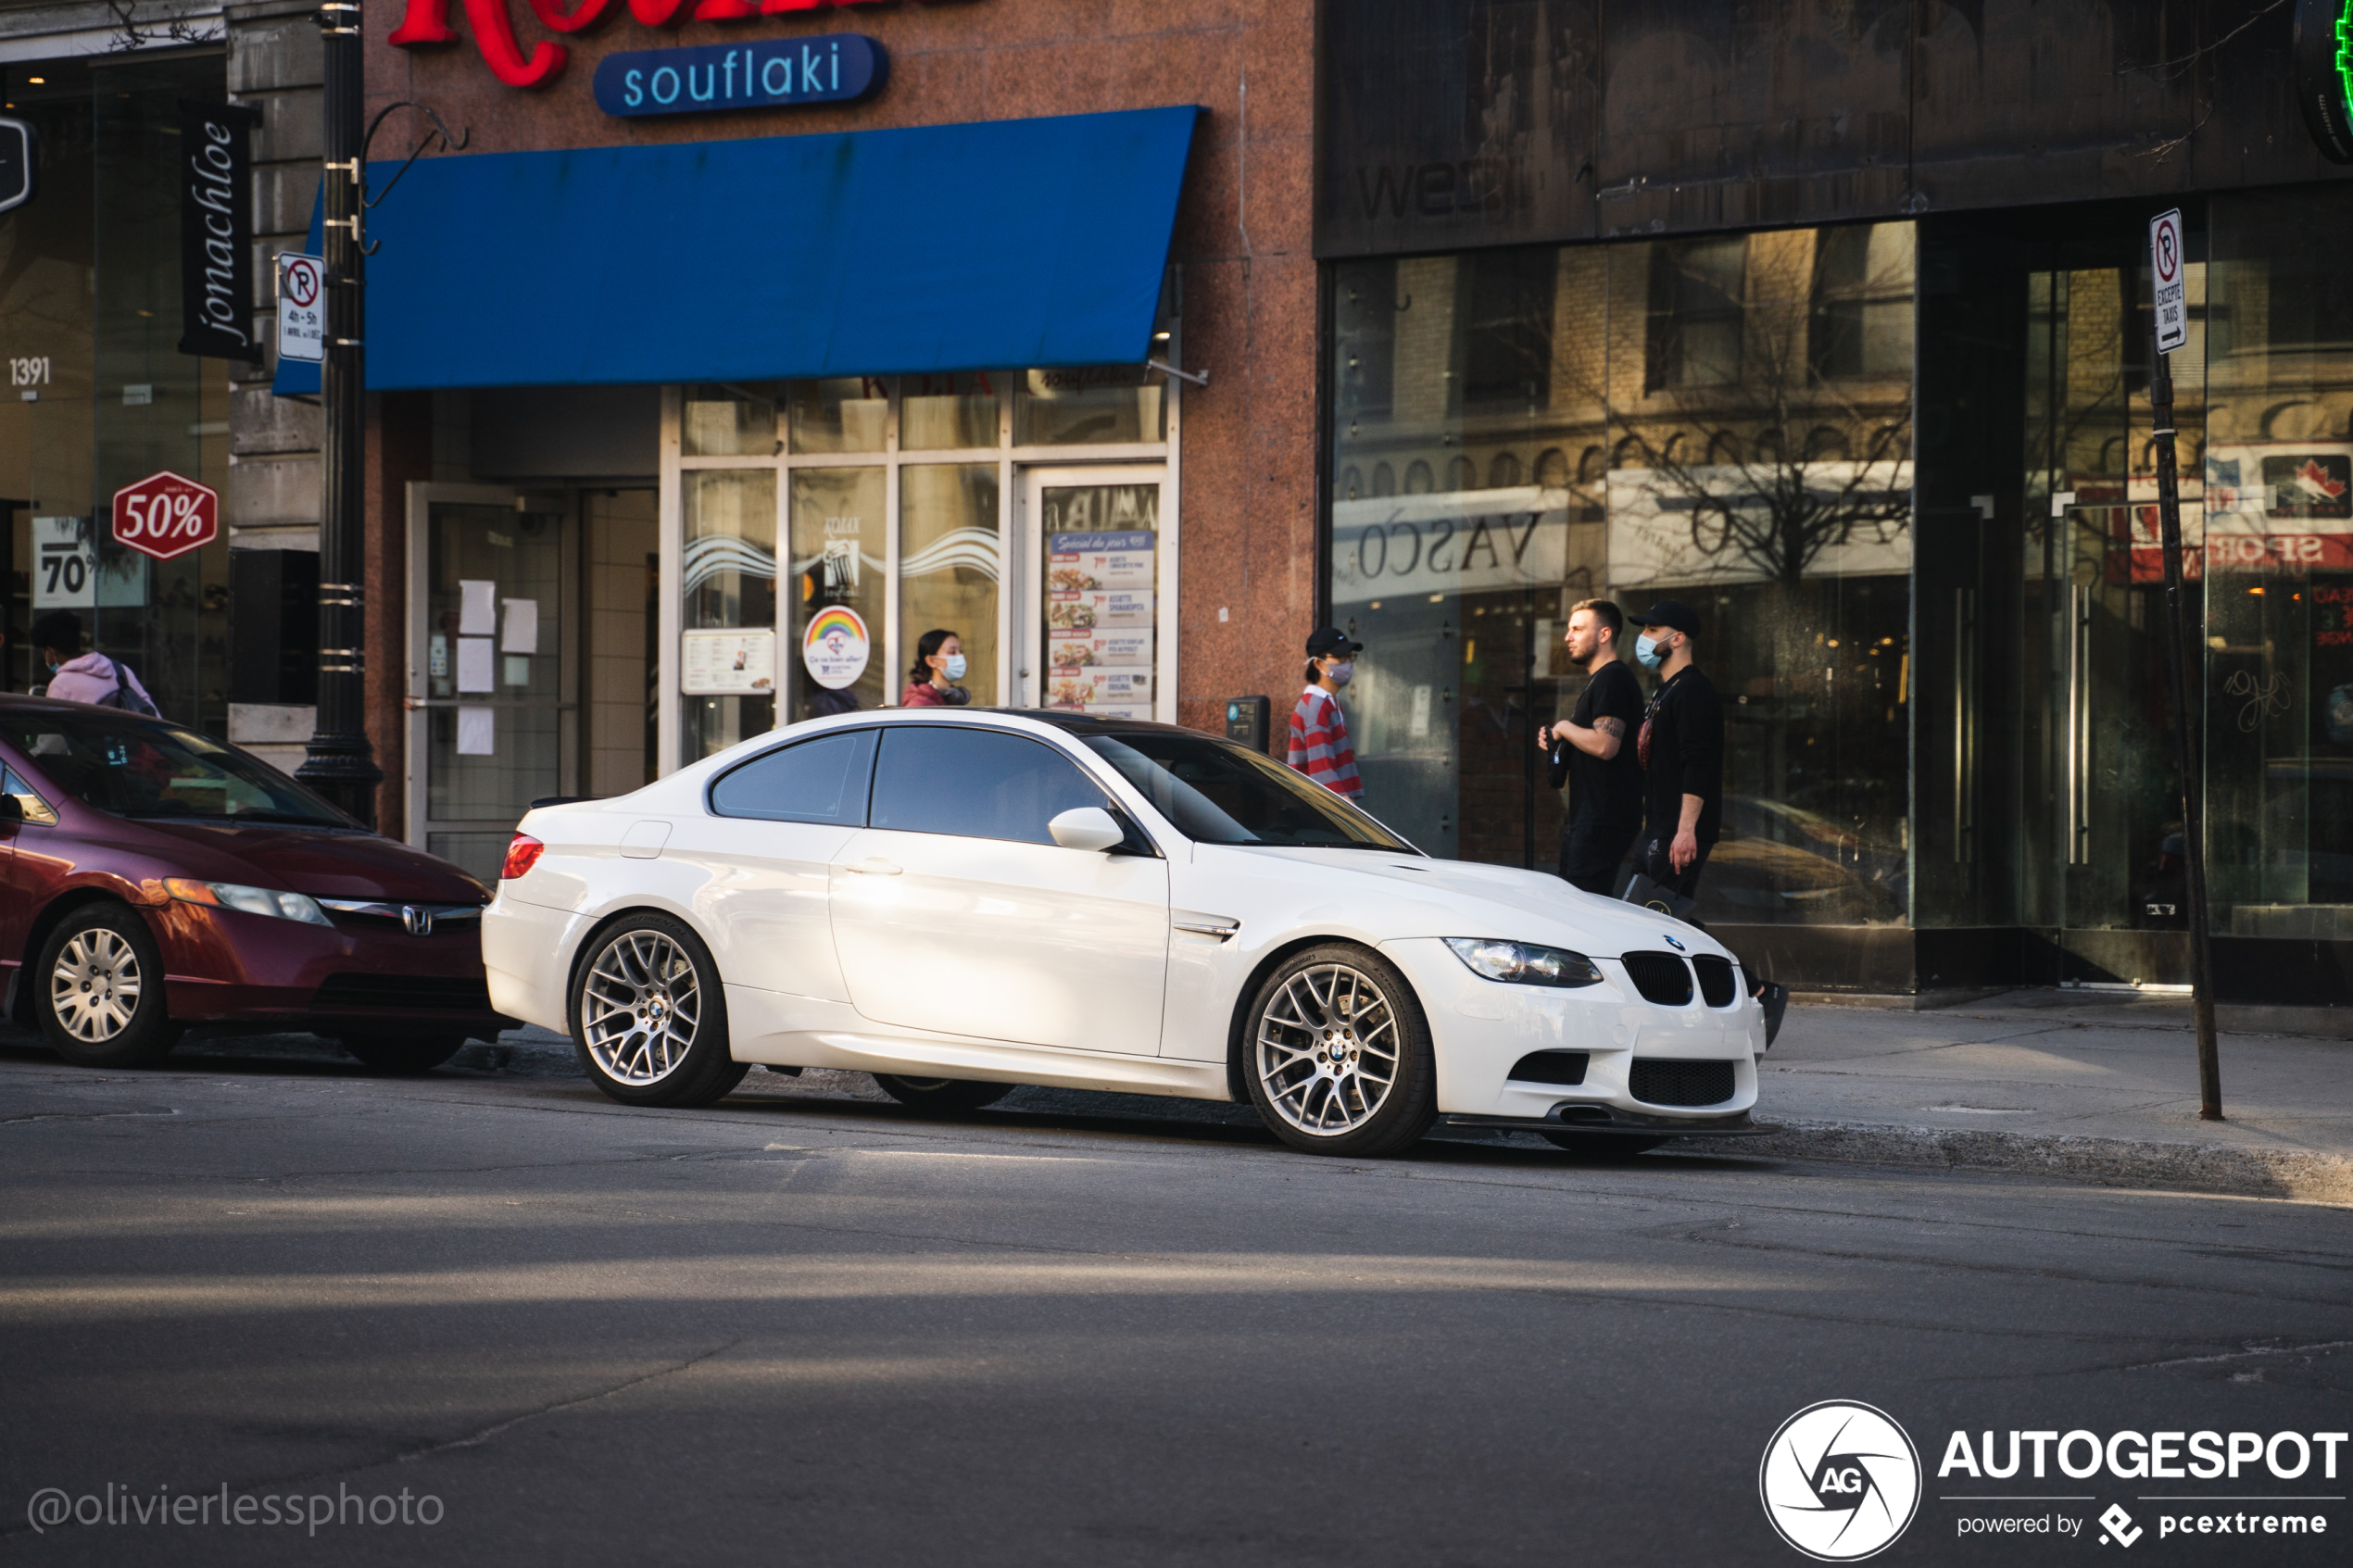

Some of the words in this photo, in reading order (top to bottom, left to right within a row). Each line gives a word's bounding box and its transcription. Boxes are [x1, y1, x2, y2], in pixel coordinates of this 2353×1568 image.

[623, 42, 839, 107] souflaki
[192, 121, 247, 346] jonachloe
[2158, 280, 2181, 307] EXCEPTÉ
[2163, 305, 2178, 324] TAXIS
[10, 357, 50, 385] 1391
[122, 493, 206, 538] 50%
